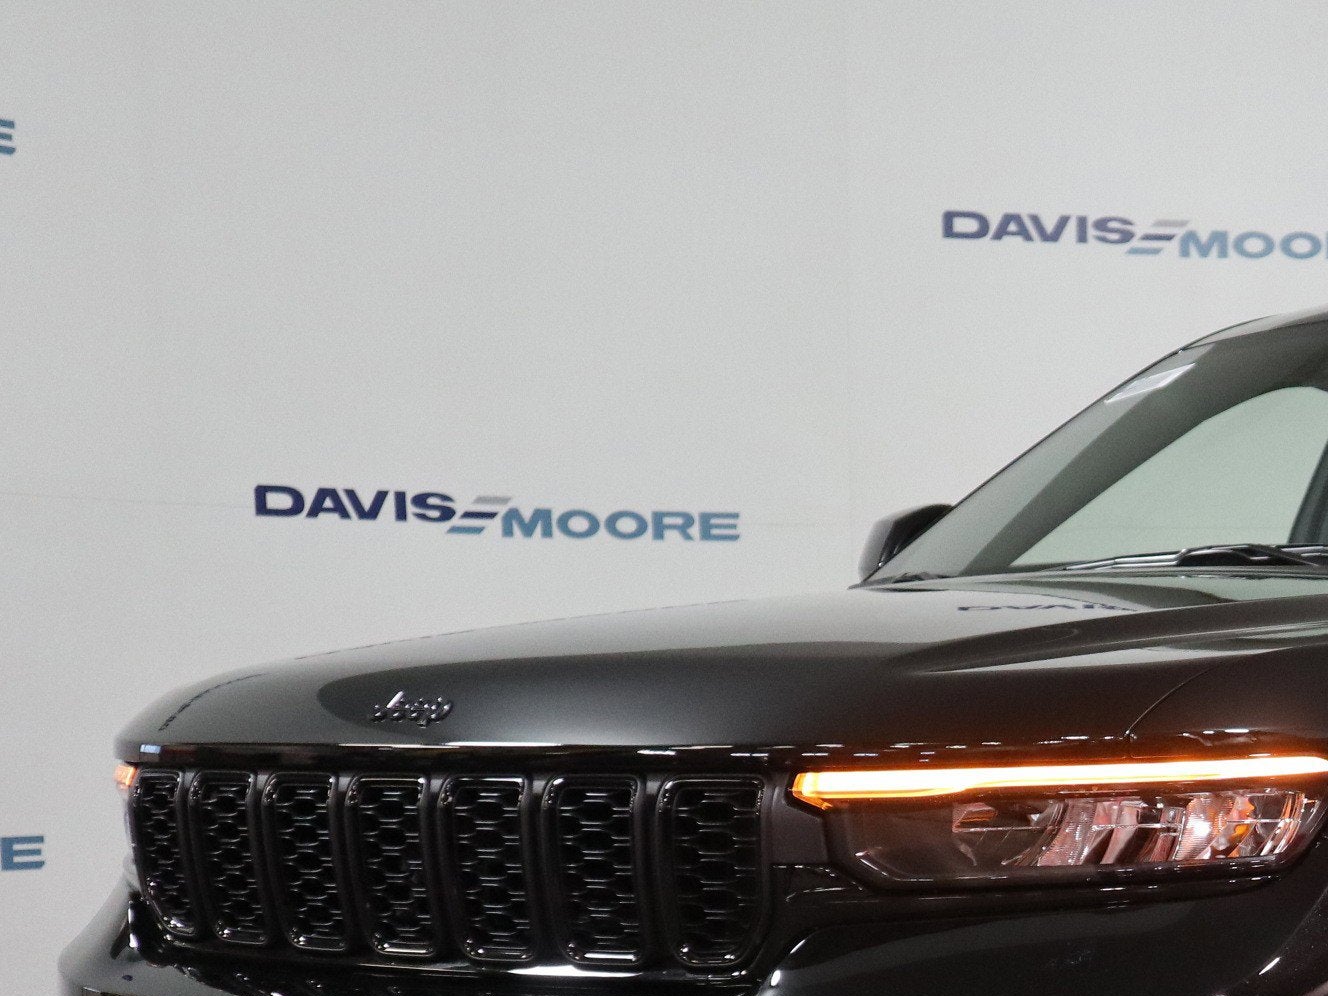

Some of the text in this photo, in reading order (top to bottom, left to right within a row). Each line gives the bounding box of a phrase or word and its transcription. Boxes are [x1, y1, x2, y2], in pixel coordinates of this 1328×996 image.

[942, 210, 1133, 245] DAVIS
[254, 484, 741, 543] DAVIS MOORE
